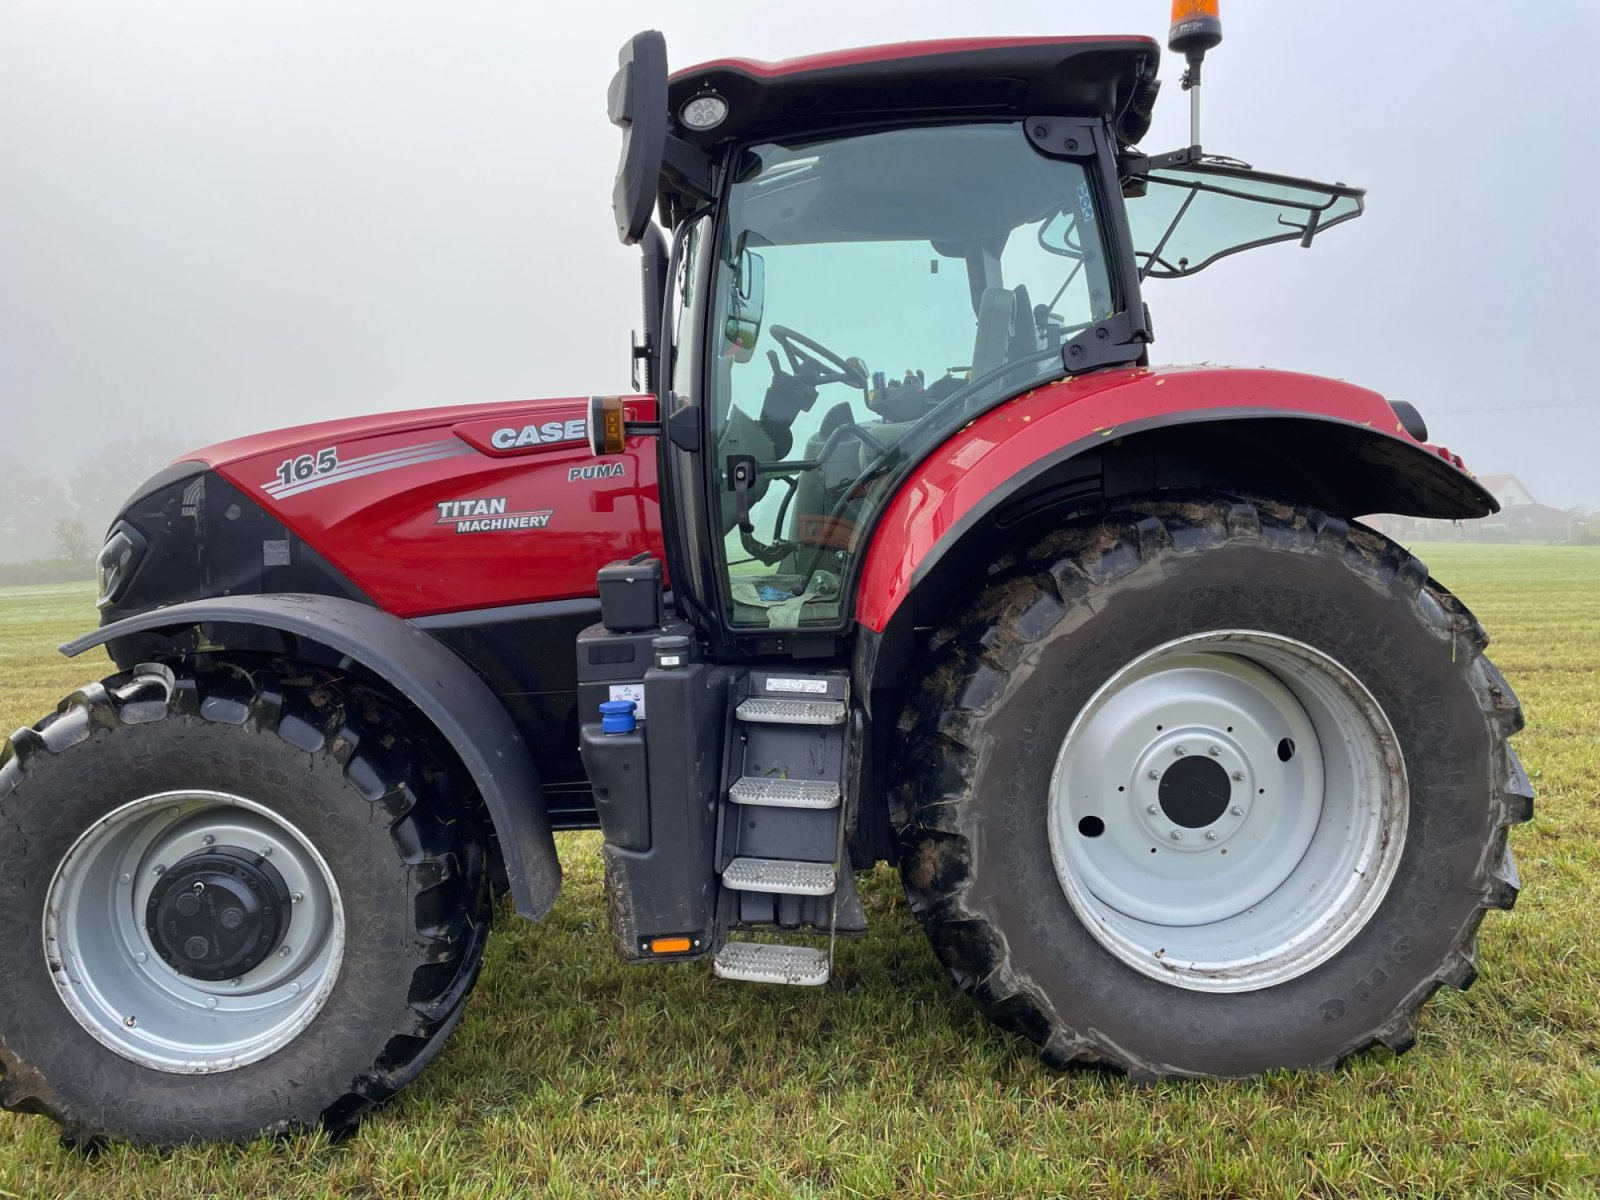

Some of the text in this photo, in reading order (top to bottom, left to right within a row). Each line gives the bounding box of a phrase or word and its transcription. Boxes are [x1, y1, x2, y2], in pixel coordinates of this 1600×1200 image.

[491, 419, 586, 449] CASE
[276, 446, 339, 487] 165
[567, 462, 625, 482] PUMA
[437, 497, 507, 518] TITAN
[457, 515, 550, 533] MACHINERY
